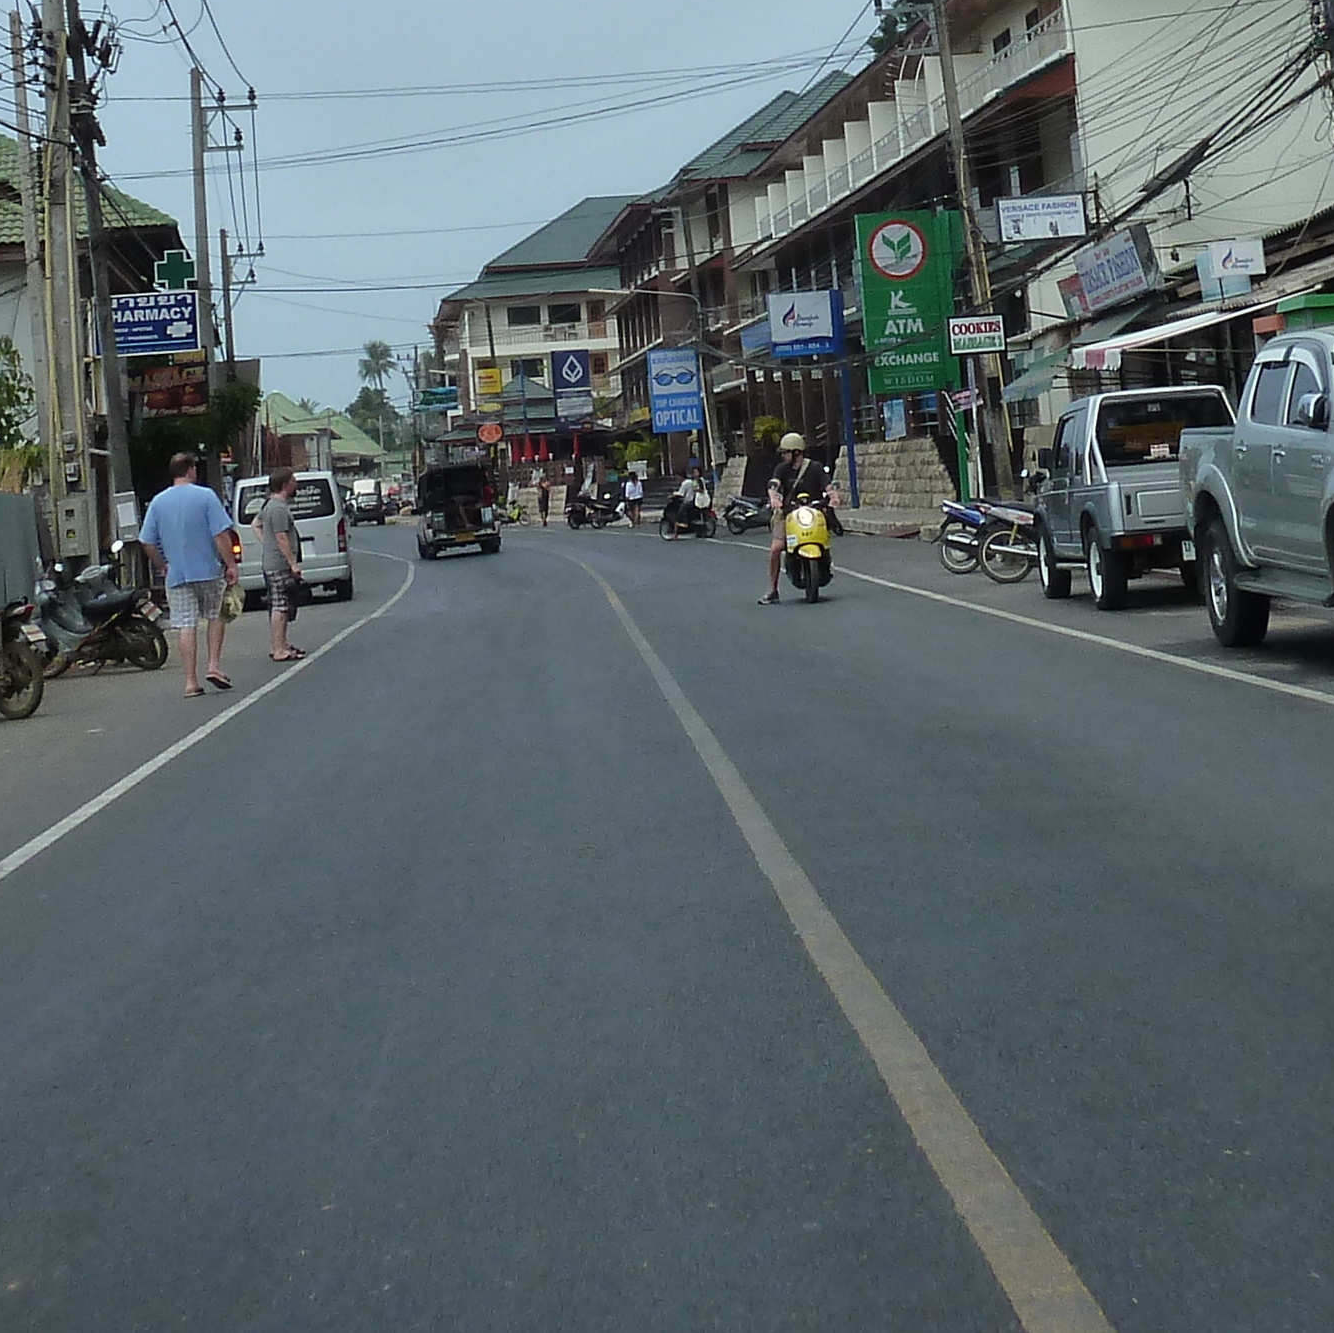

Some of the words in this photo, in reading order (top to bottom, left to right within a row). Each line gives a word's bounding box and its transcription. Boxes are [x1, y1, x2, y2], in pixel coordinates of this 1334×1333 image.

[112, 306, 193, 323] HARMACY
[884, 317, 925, 336] ATM
[952, 320, 1002, 336] COOKIES
[883, 374, 935, 386] WISDOM
[655, 408, 700, 427] OPTICAL
